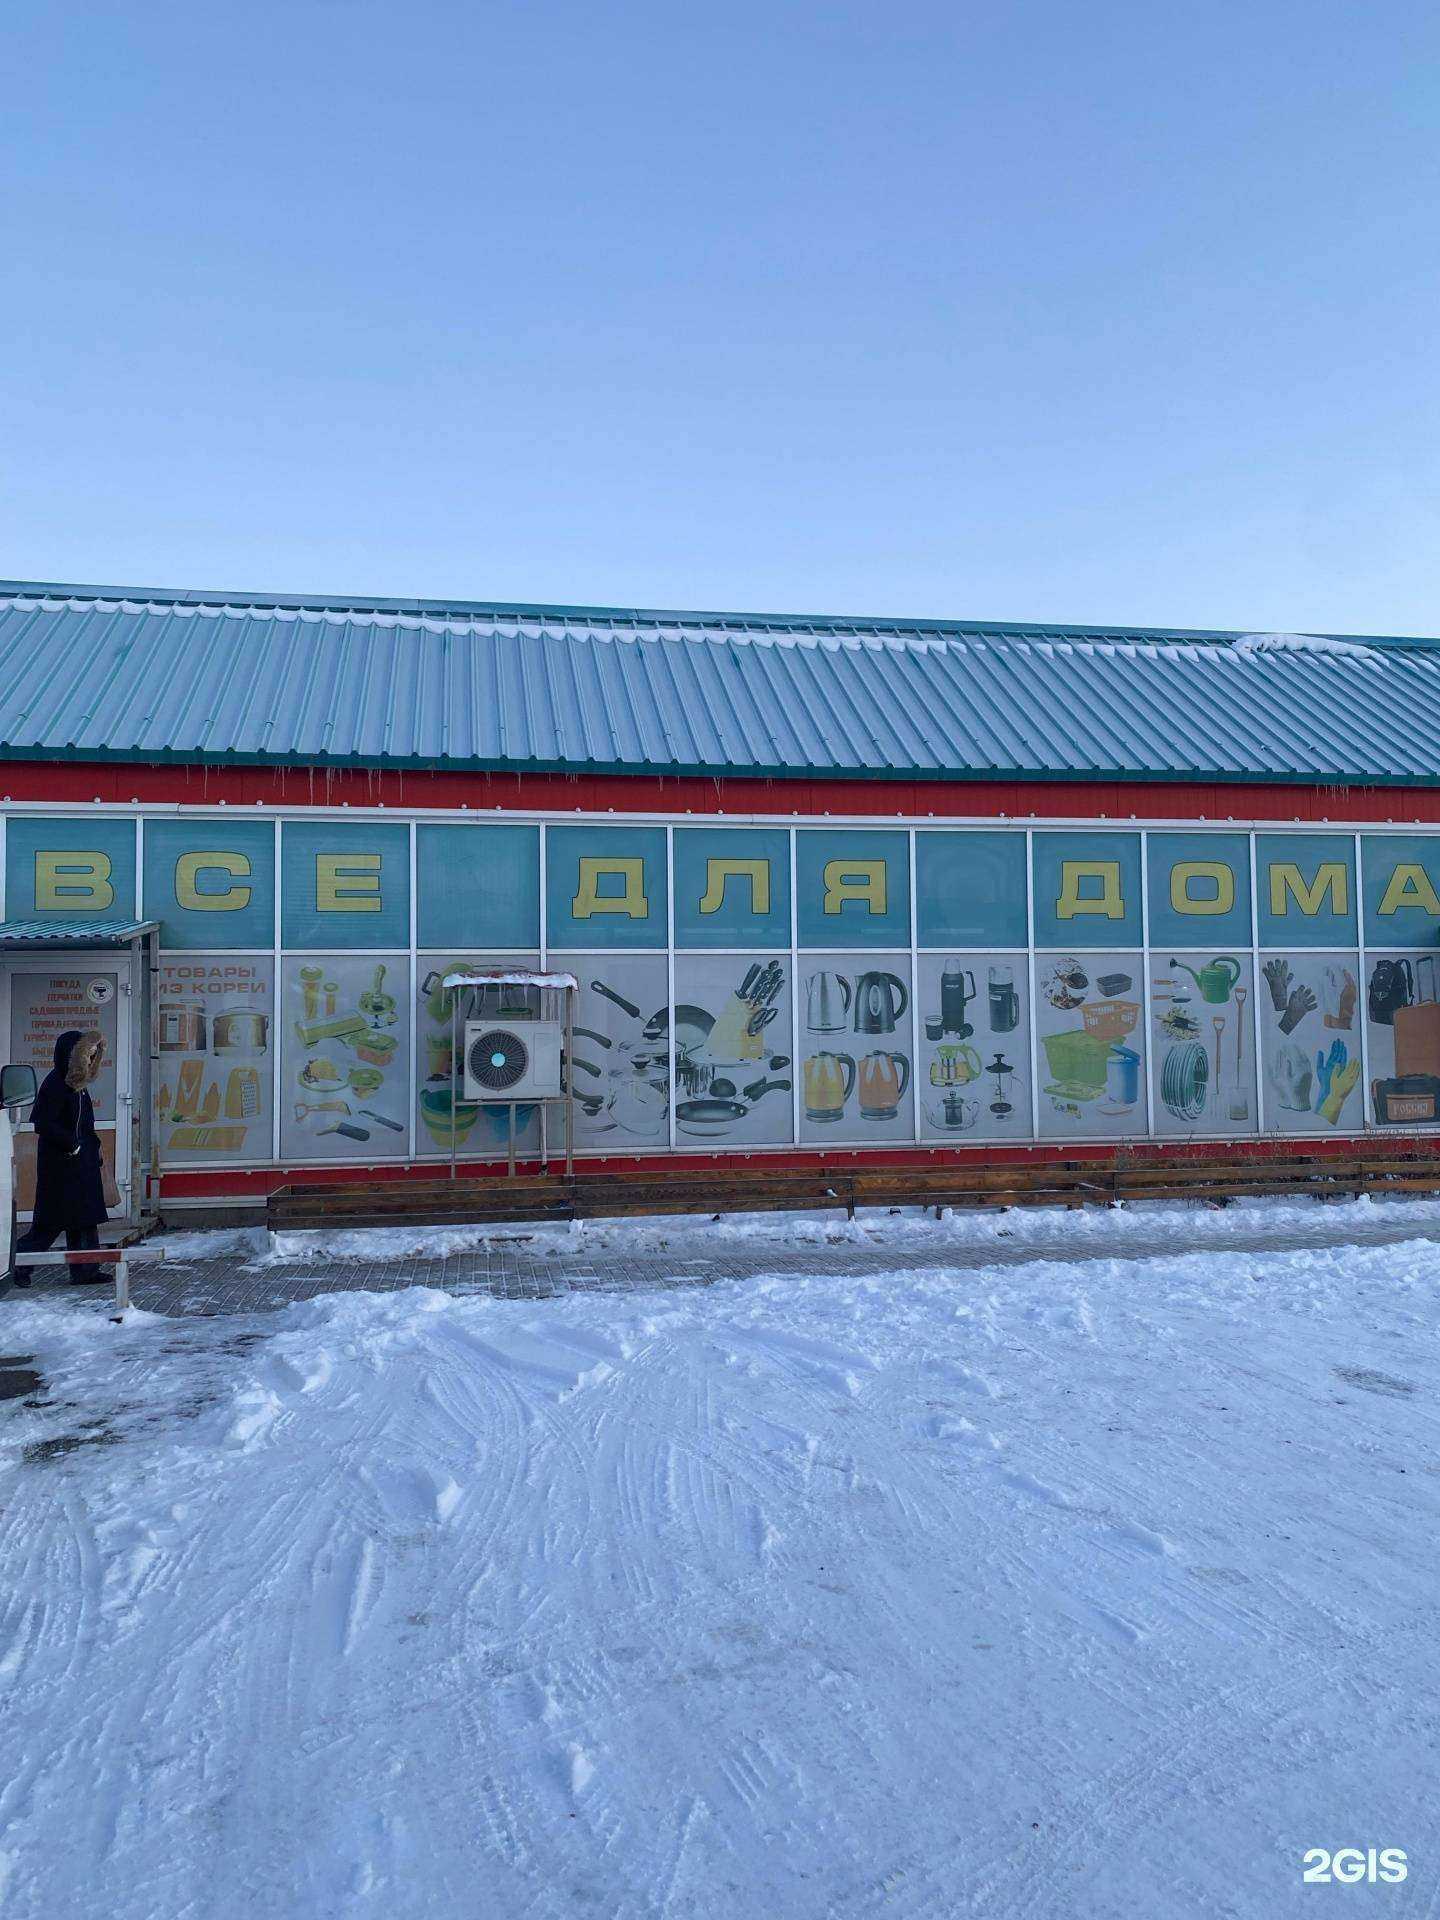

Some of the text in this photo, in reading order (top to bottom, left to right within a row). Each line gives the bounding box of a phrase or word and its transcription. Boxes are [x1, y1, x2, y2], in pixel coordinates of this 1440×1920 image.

[34, 850, 1440, 919] ВСЕ ДЛЯ ДОМА
[163, 967, 256, 978] ТОВАРЫ
